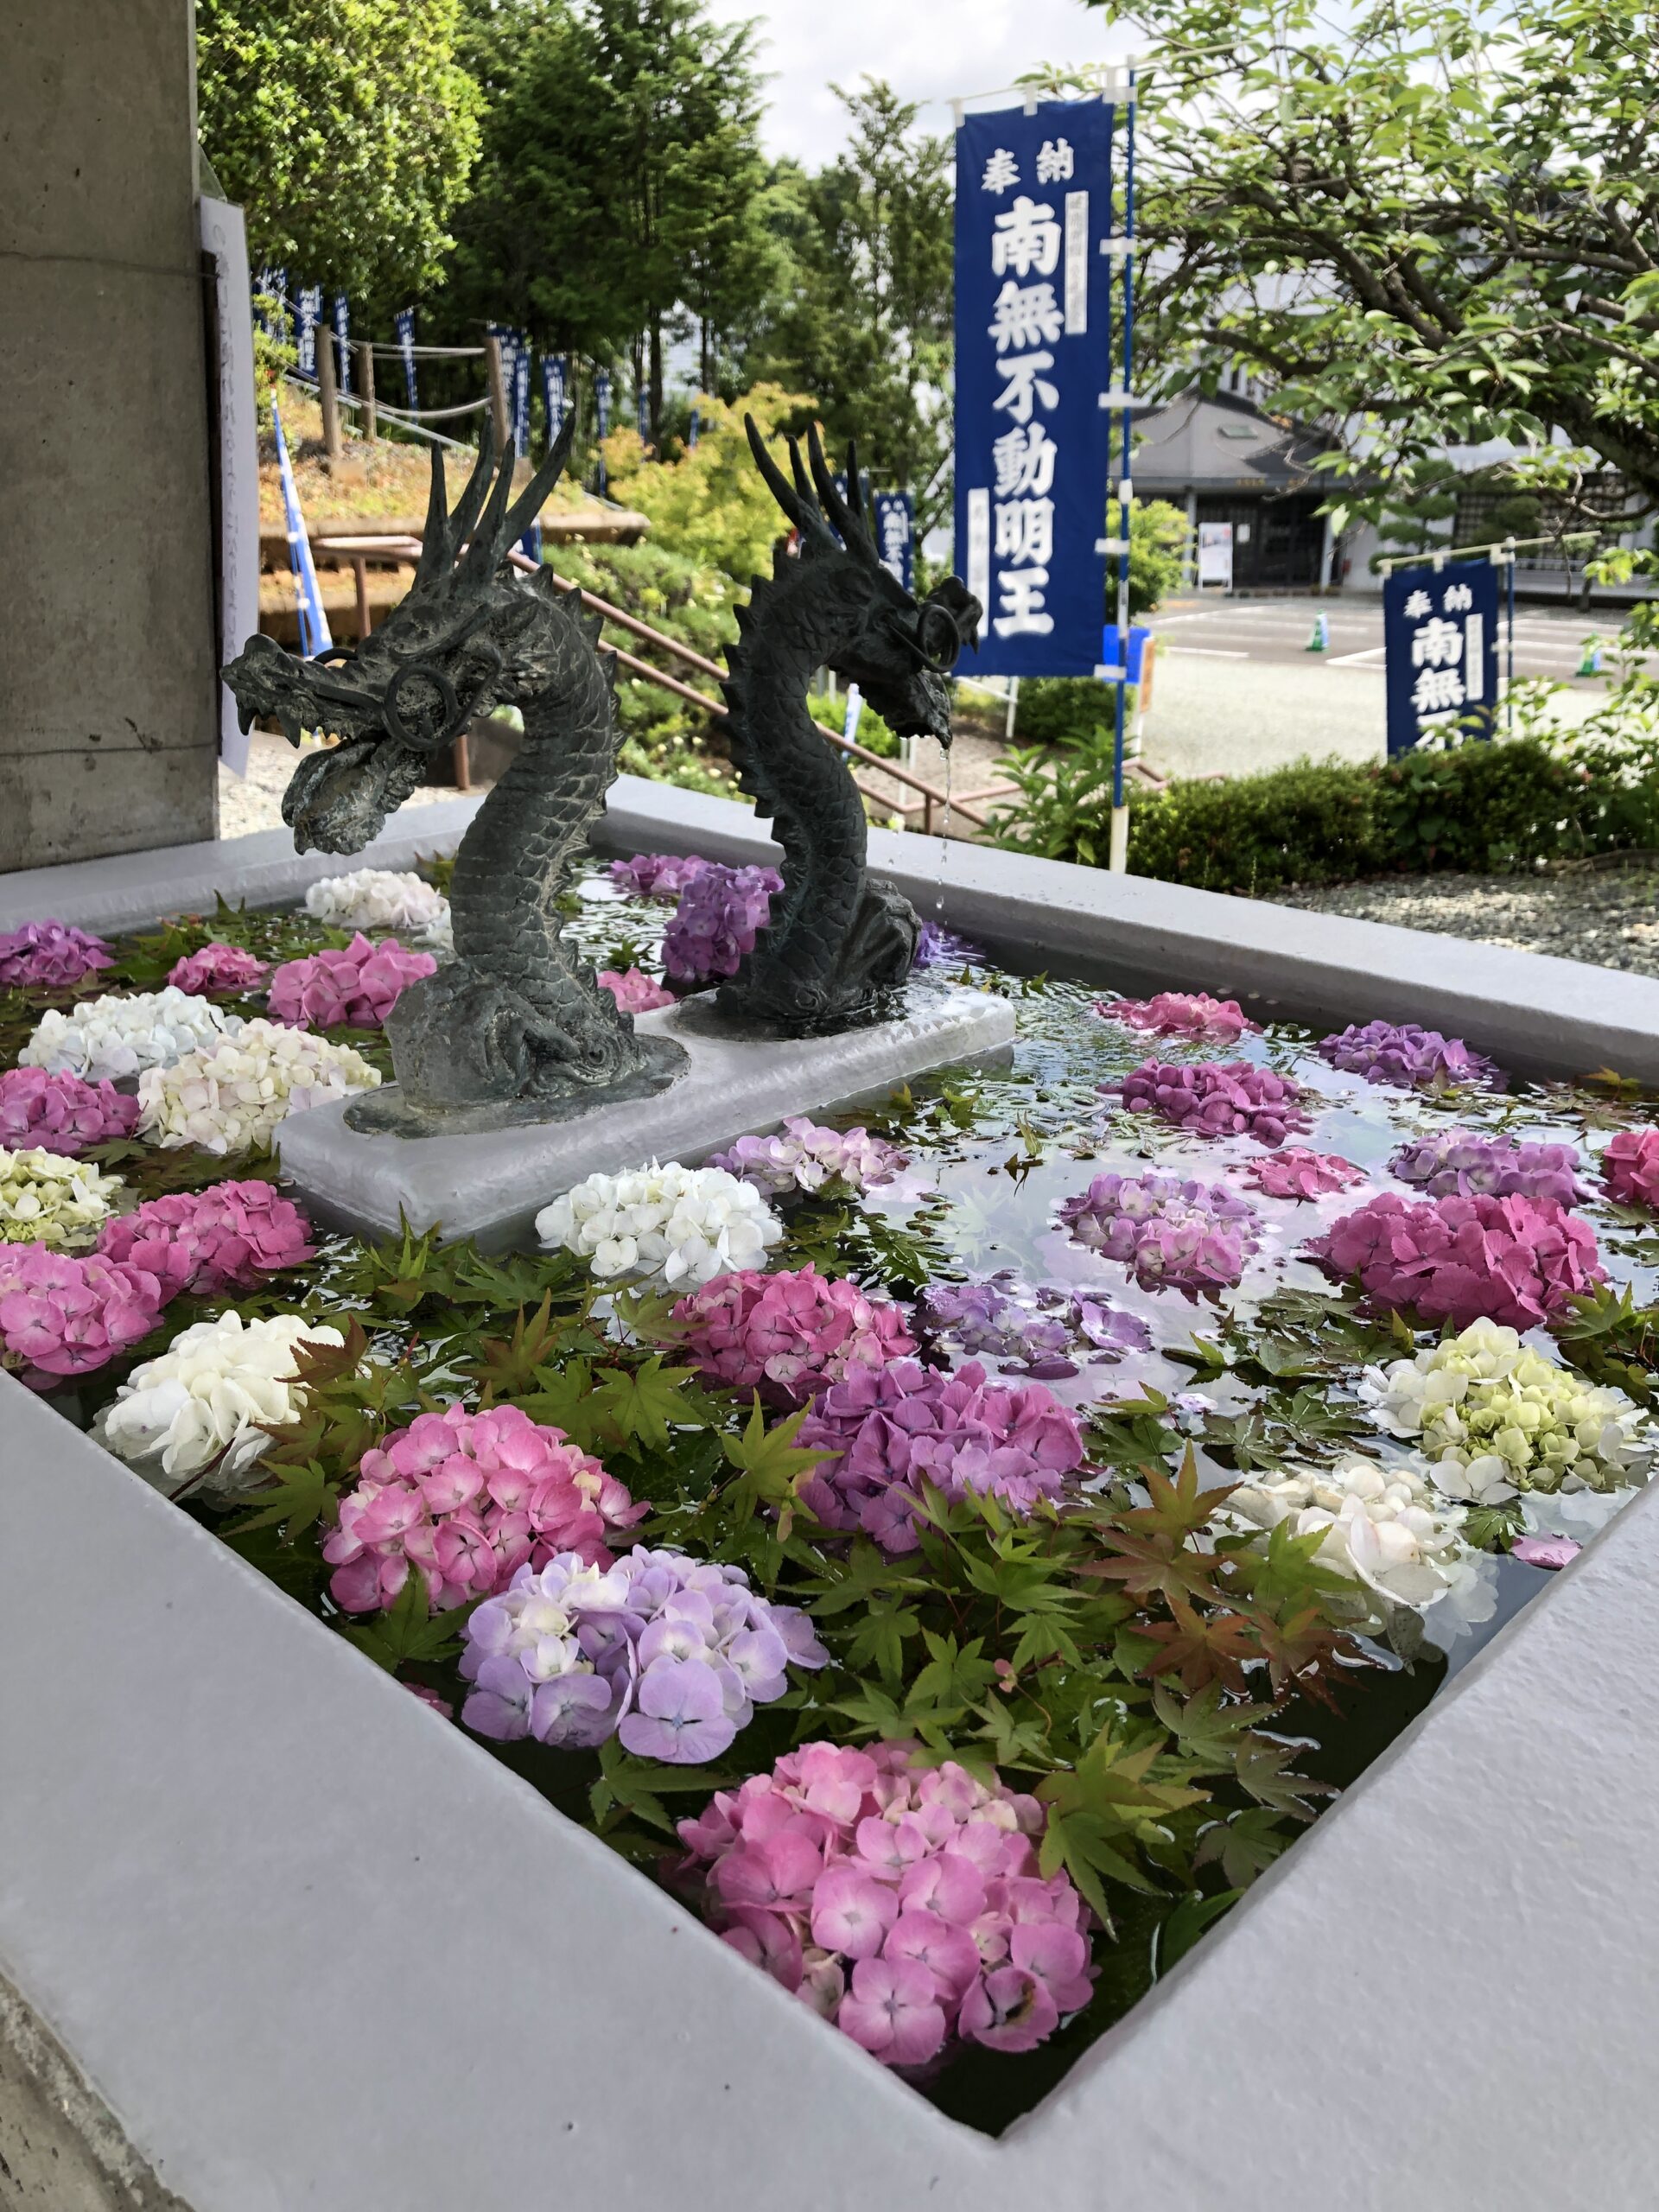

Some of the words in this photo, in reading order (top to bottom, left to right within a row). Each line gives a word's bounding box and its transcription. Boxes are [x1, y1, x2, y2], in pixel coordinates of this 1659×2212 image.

[982, 137, 1074, 193] 奉納
[988, 195, 1064, 636] 南無不動明王
[1404, 583, 1472, 619] 奉納
